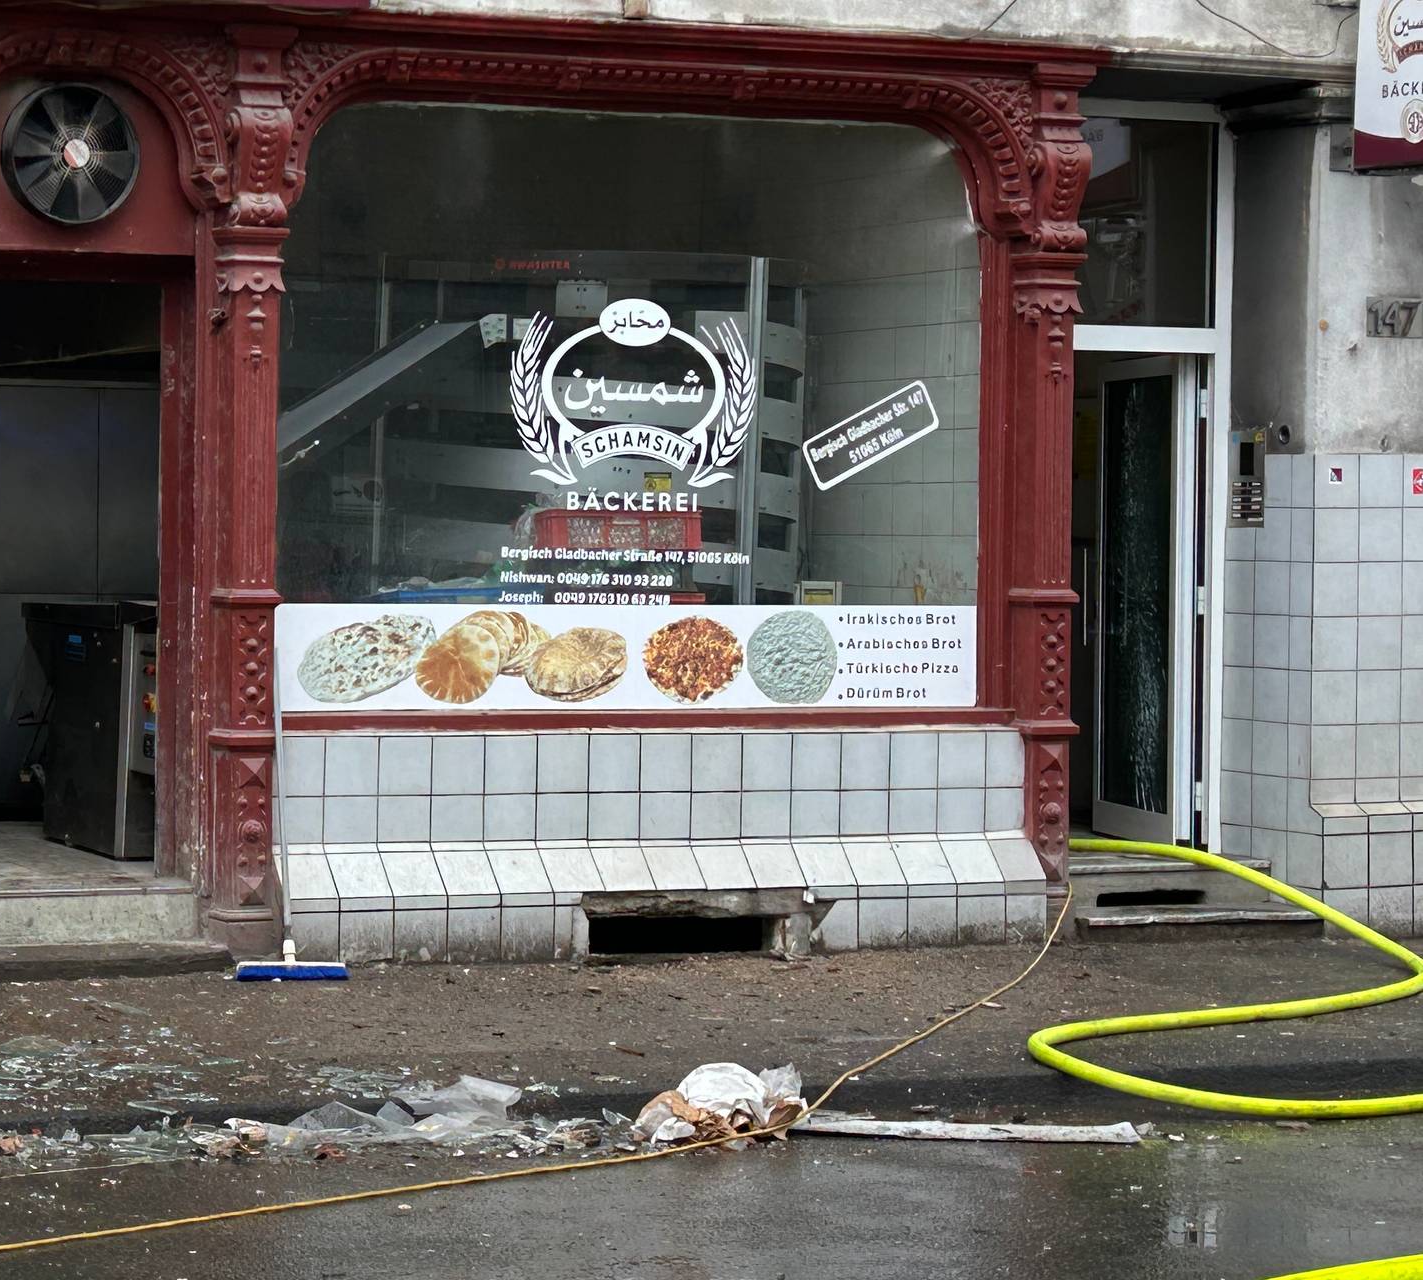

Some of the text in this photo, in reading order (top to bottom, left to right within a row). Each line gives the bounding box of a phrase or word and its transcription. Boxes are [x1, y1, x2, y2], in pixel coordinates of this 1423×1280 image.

[1382, 81, 1423, 98] BÄCK
[1367, 300, 1422, 336] 147
[564, 368, 704, 414] شمسين
[907, 390, 924, 408] 147
[879, 427, 905, 446] Köln
[581, 431, 686, 462] SCHAMSIN
[566, 487, 698, 512] BÄCKEREI
[501, 546, 552, 561] Bergisch
[555, 548, 622, 562] Gladbacher
[623, 549, 663, 563] Straße
[687, 551, 722, 564] 51065
[724, 553, 750, 565] Köln
[500, 570, 554, 584] Nishwan:
[557, 572, 589, 585] 0049
[590, 573, 610, 585] 176
[611, 574, 632, 586] 310
[634, 575, 649, 586] 93
[498, 590, 544, 605] Joseph:
[554, 592, 586, 604] 0049
[846, 613, 956, 625] Irakisches Brot
[846, 638, 962, 649] Arabisches Brot
[846, 663, 959, 674] Türkische Pizza
[846, 688, 927, 699] Dürüm Brot
